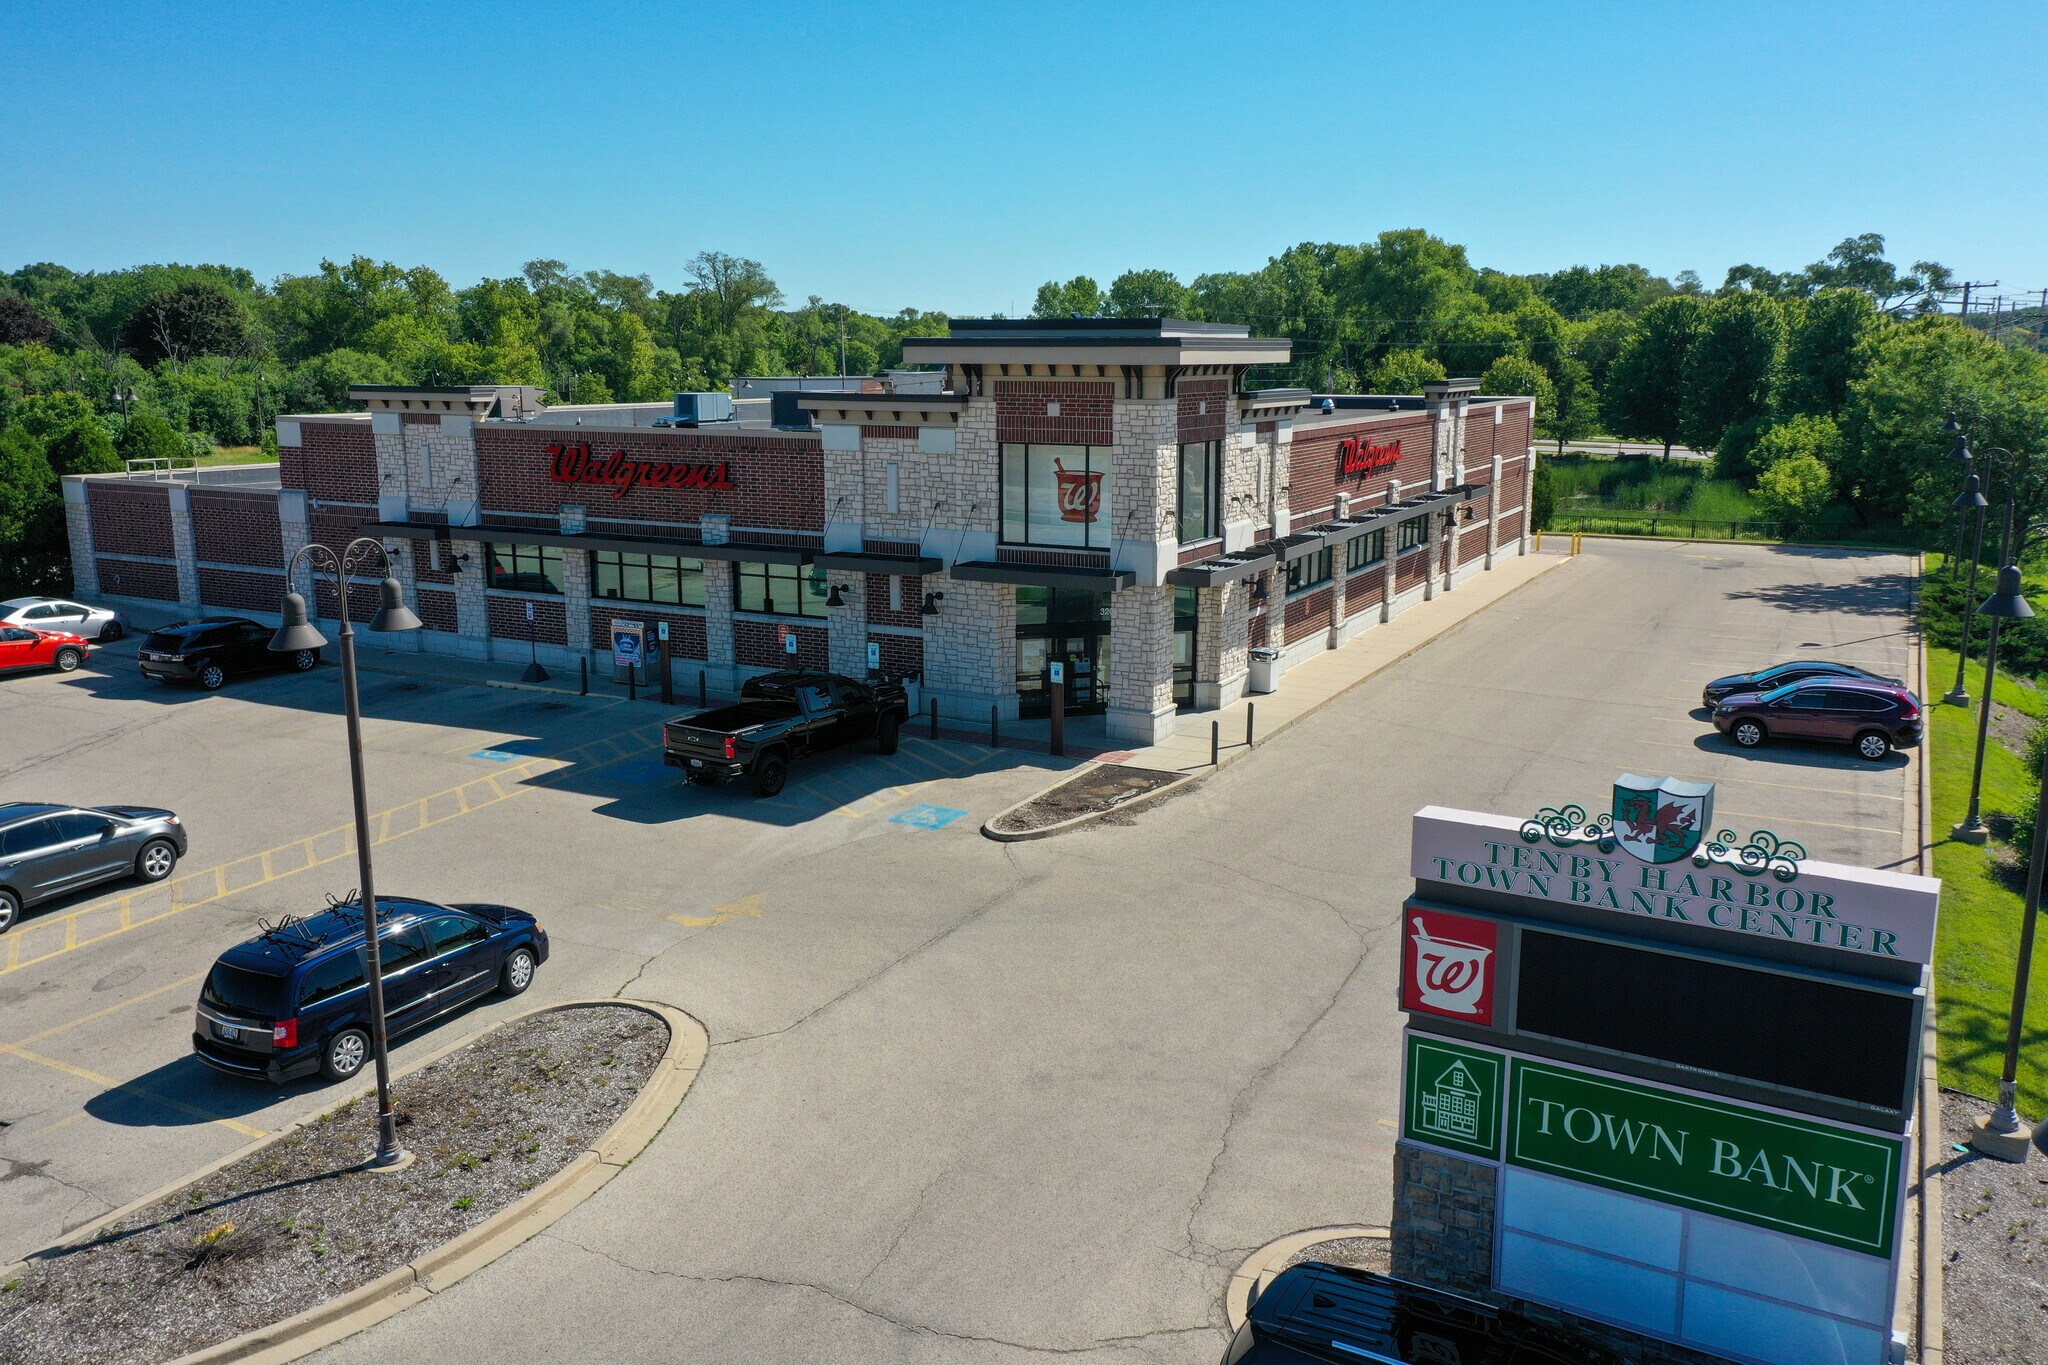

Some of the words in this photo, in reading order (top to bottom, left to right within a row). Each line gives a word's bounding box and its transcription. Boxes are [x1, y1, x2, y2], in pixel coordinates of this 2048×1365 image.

[546, 443, 734, 499] Walgreens
[1061, 481, 1098, 511] W
[1099, 607, 1111, 616] 32
[1432, 856, 1554, 898] TOWN
[1568, 879, 1693, 922] BANK
[1707, 904, 1902, 958] CENTER
[1484, 840, 1621, 884] TENBY
[1638, 864, 1840, 920] HARBOR
[1421, 952, 1480, 994] W
[1528, 1097, 1690, 1166] TOWN
